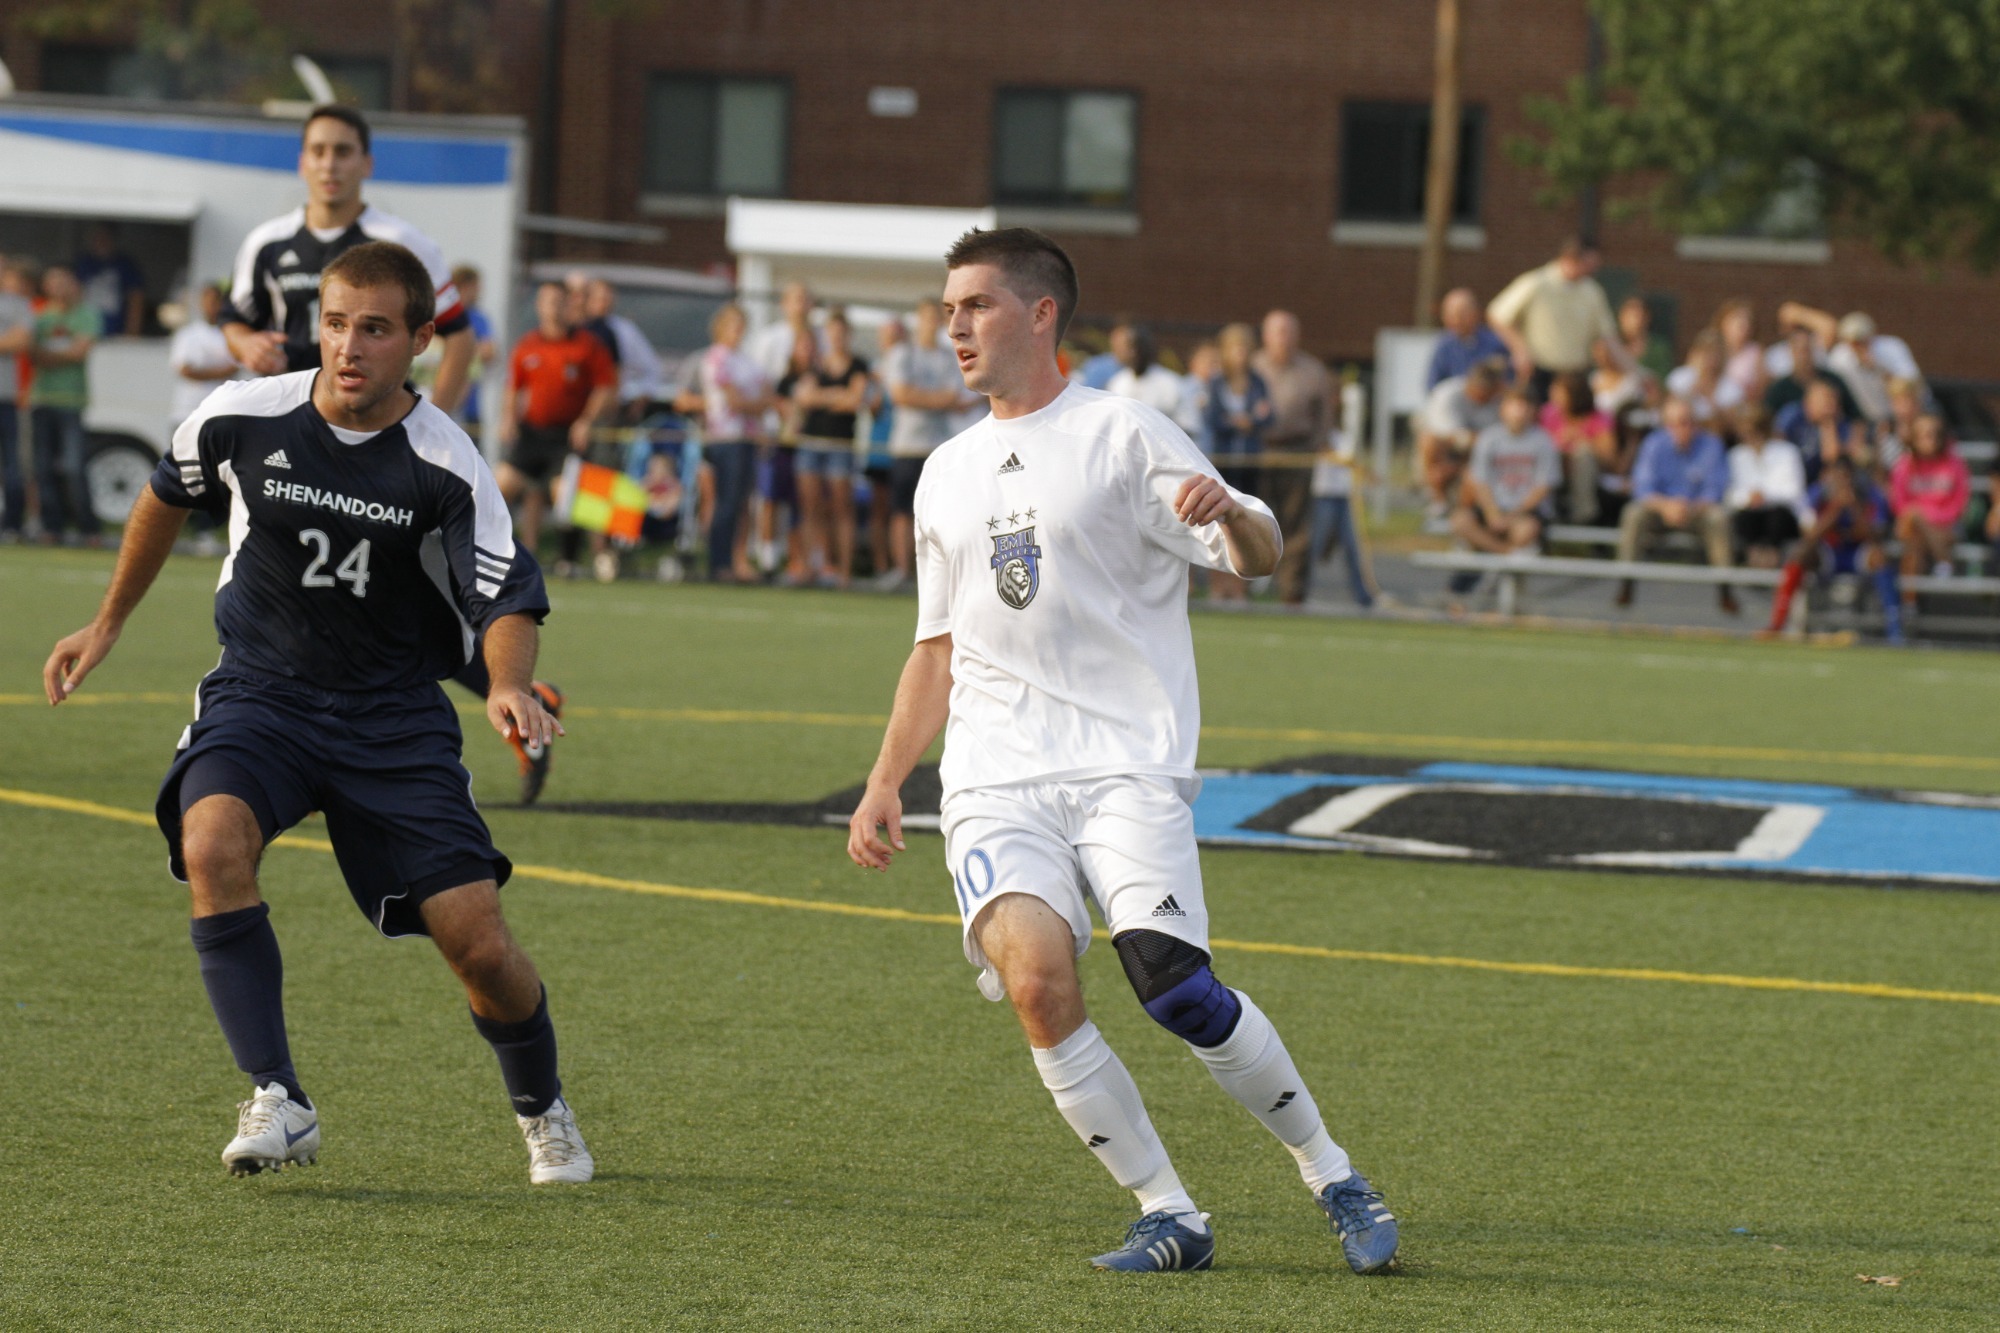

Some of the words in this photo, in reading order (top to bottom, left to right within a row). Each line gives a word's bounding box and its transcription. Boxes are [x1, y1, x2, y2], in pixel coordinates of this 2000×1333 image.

[998, 464, 1025, 475] adidas
[263, 479, 413, 527] SHENANDOAH
[995, 529, 1034, 555] EMU
[299, 528, 371, 598] 24
[995, 548, 1038, 565] SOCCER
[1152, 907, 1187, 917] adidas
